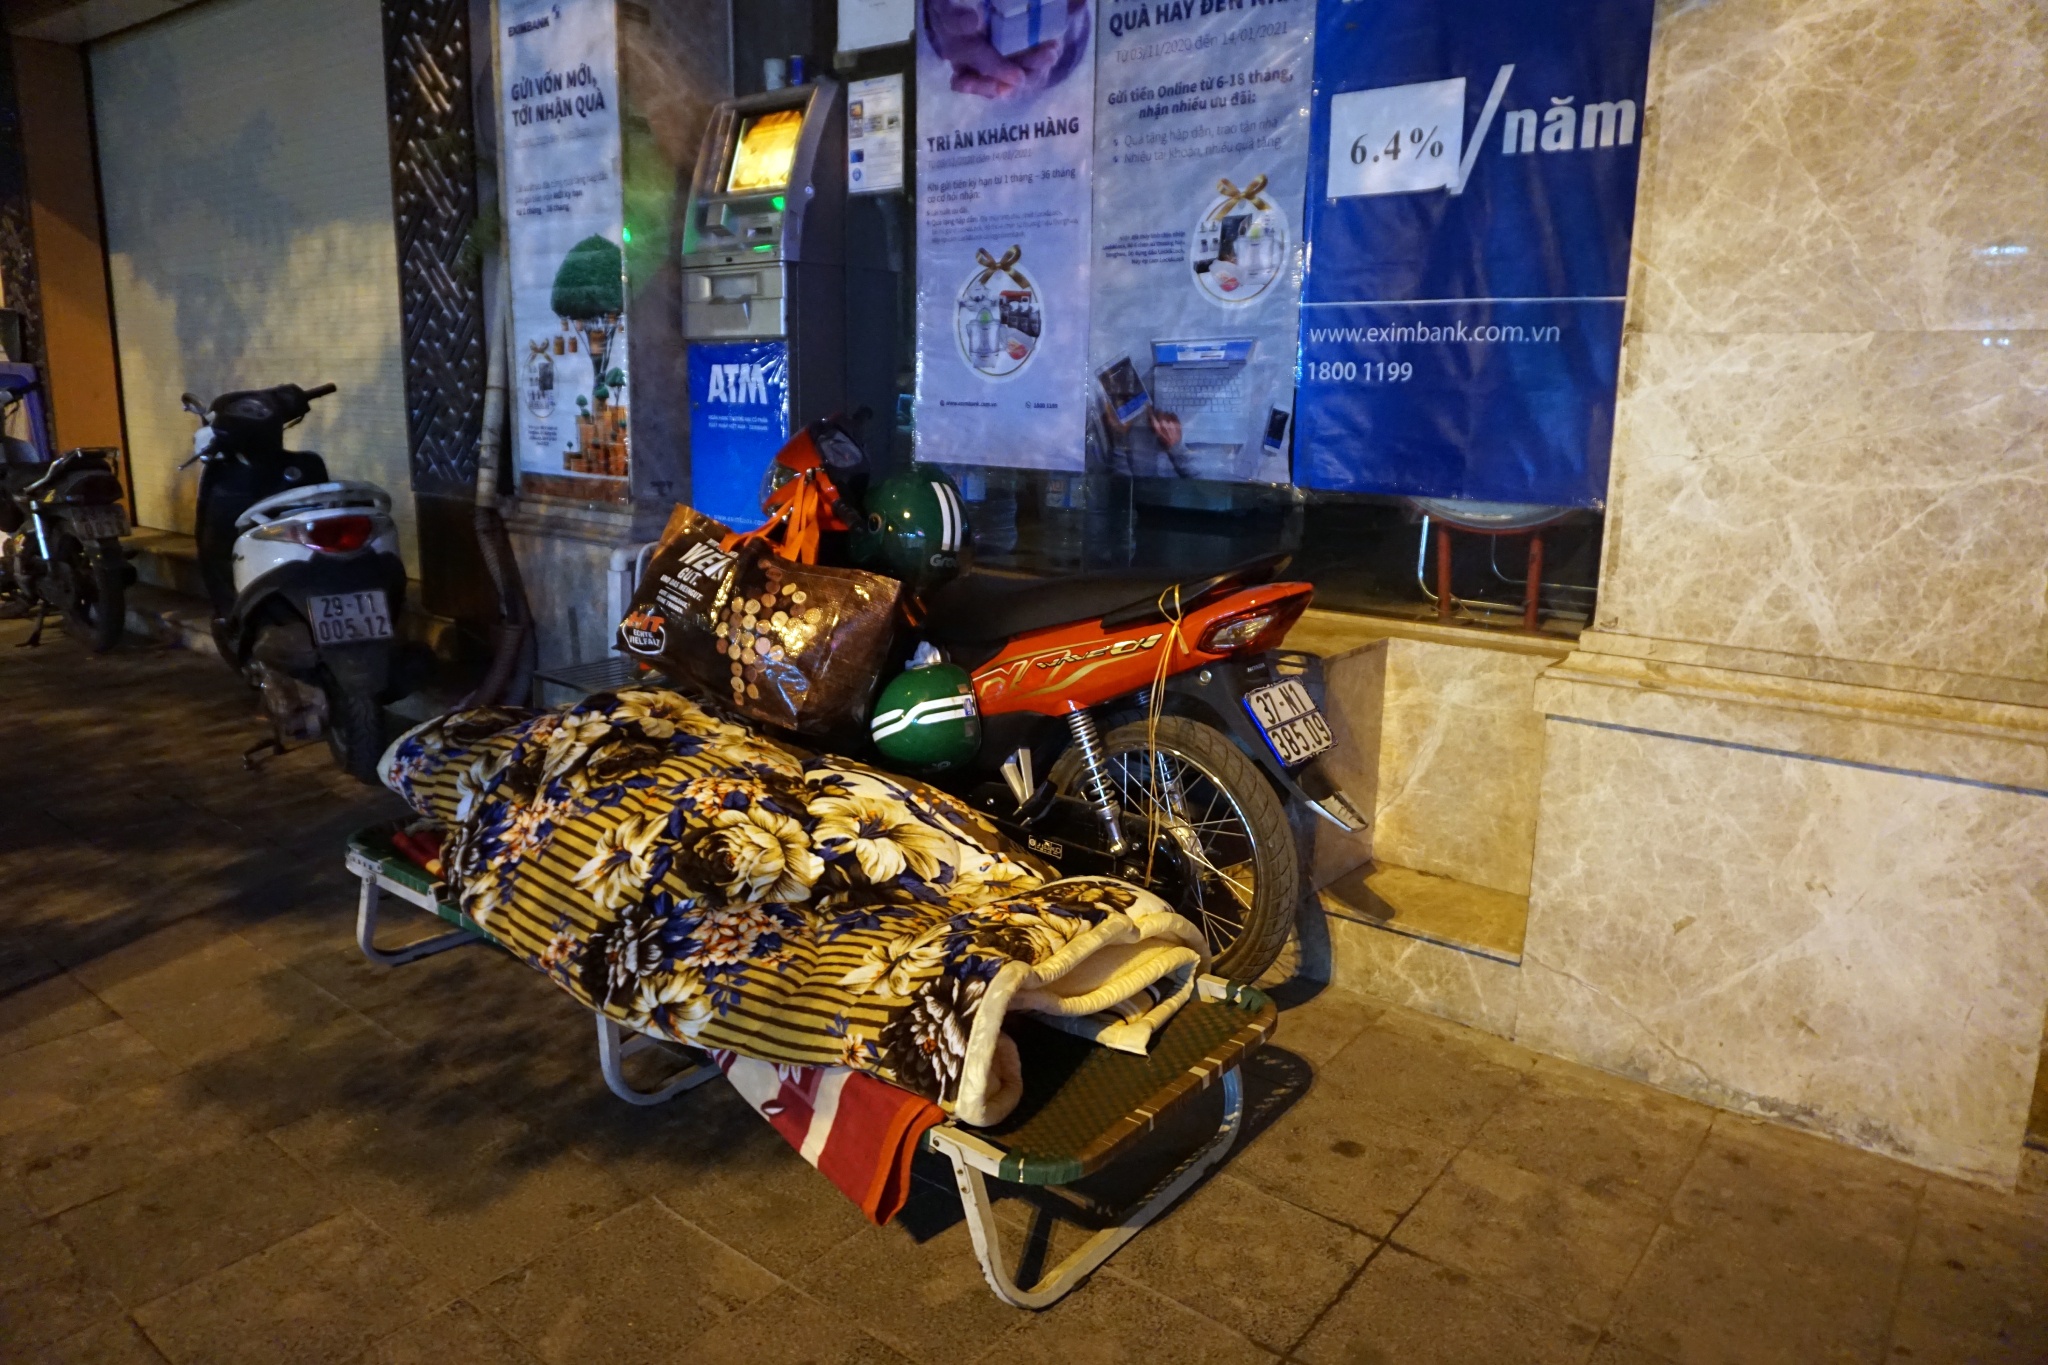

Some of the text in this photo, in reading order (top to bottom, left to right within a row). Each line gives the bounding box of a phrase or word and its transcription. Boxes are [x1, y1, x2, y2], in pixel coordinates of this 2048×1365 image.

[1109, 6, 1151, 37] QUÀ
[1156, 0, 1195, 25] HAY
[511, 62, 598, 101] GỬI VỐN MỚI,
[1157, 81, 1198, 98] Online
[1216, 73, 1245, 89] 6-18
[1249, 68, 1295, 84] tháng,
[512, 87, 606, 127] TỚI NHẬN QUÀ
[1139, 103, 1169, 120] nhận
[927, 117, 1079, 153] TRI ÂN KHÁCH HÀNG
[1350, 125, 1444, 165] 6.4%
[1309, 321, 1561, 343] www.eximbank.com.vn
[707, 364, 768, 405] ATM
[1308, 362, 1413, 381] 1800 1199
[677, 567, 702, 586] GUT.
[321, 592, 377, 618] 29-T1
[626, 611, 664, 632] HIT
[1255, 683, 1308, 725] 37-N1
[1271, 713, 1331, 761] 385.09
